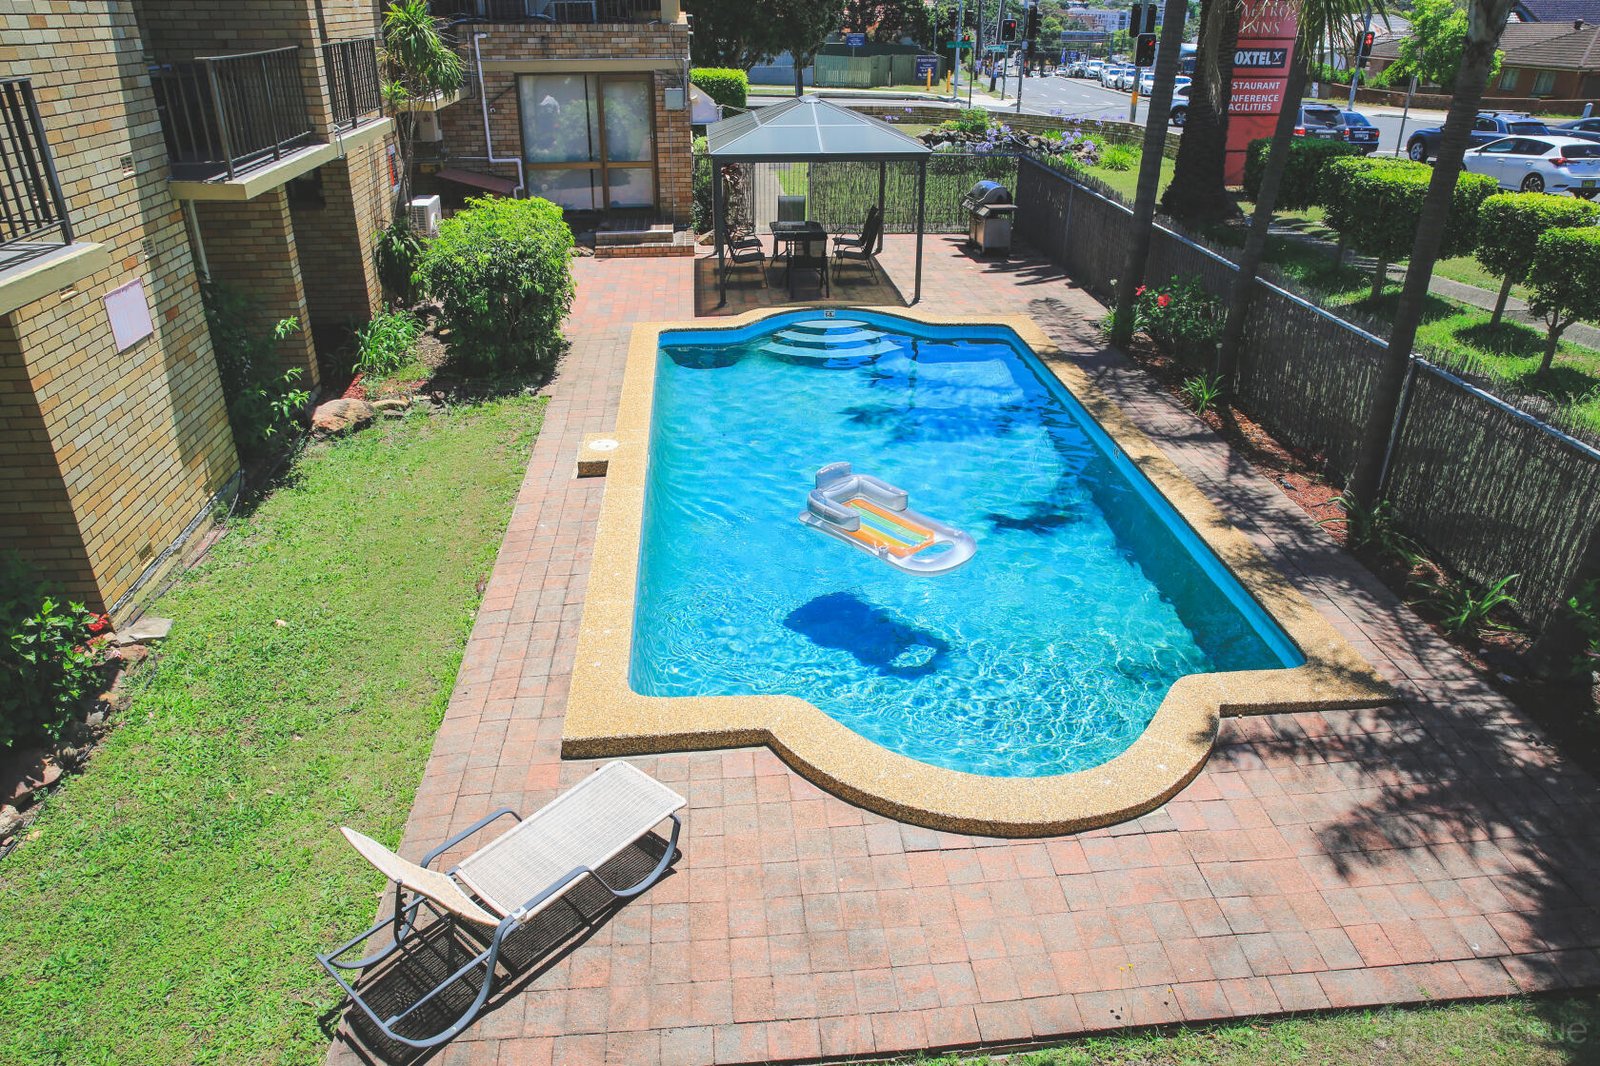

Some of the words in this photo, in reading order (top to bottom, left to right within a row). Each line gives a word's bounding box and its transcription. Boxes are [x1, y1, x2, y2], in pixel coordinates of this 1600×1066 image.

[1241, 21, 1281, 34] INNS
[1233, 50, 1272, 65] OXTEL
[1231, 81, 1280, 90] STAURANT
[1231, 94, 1280, 102] NFERENCE
[1228, 103, 1272, 111] ACILITIES
